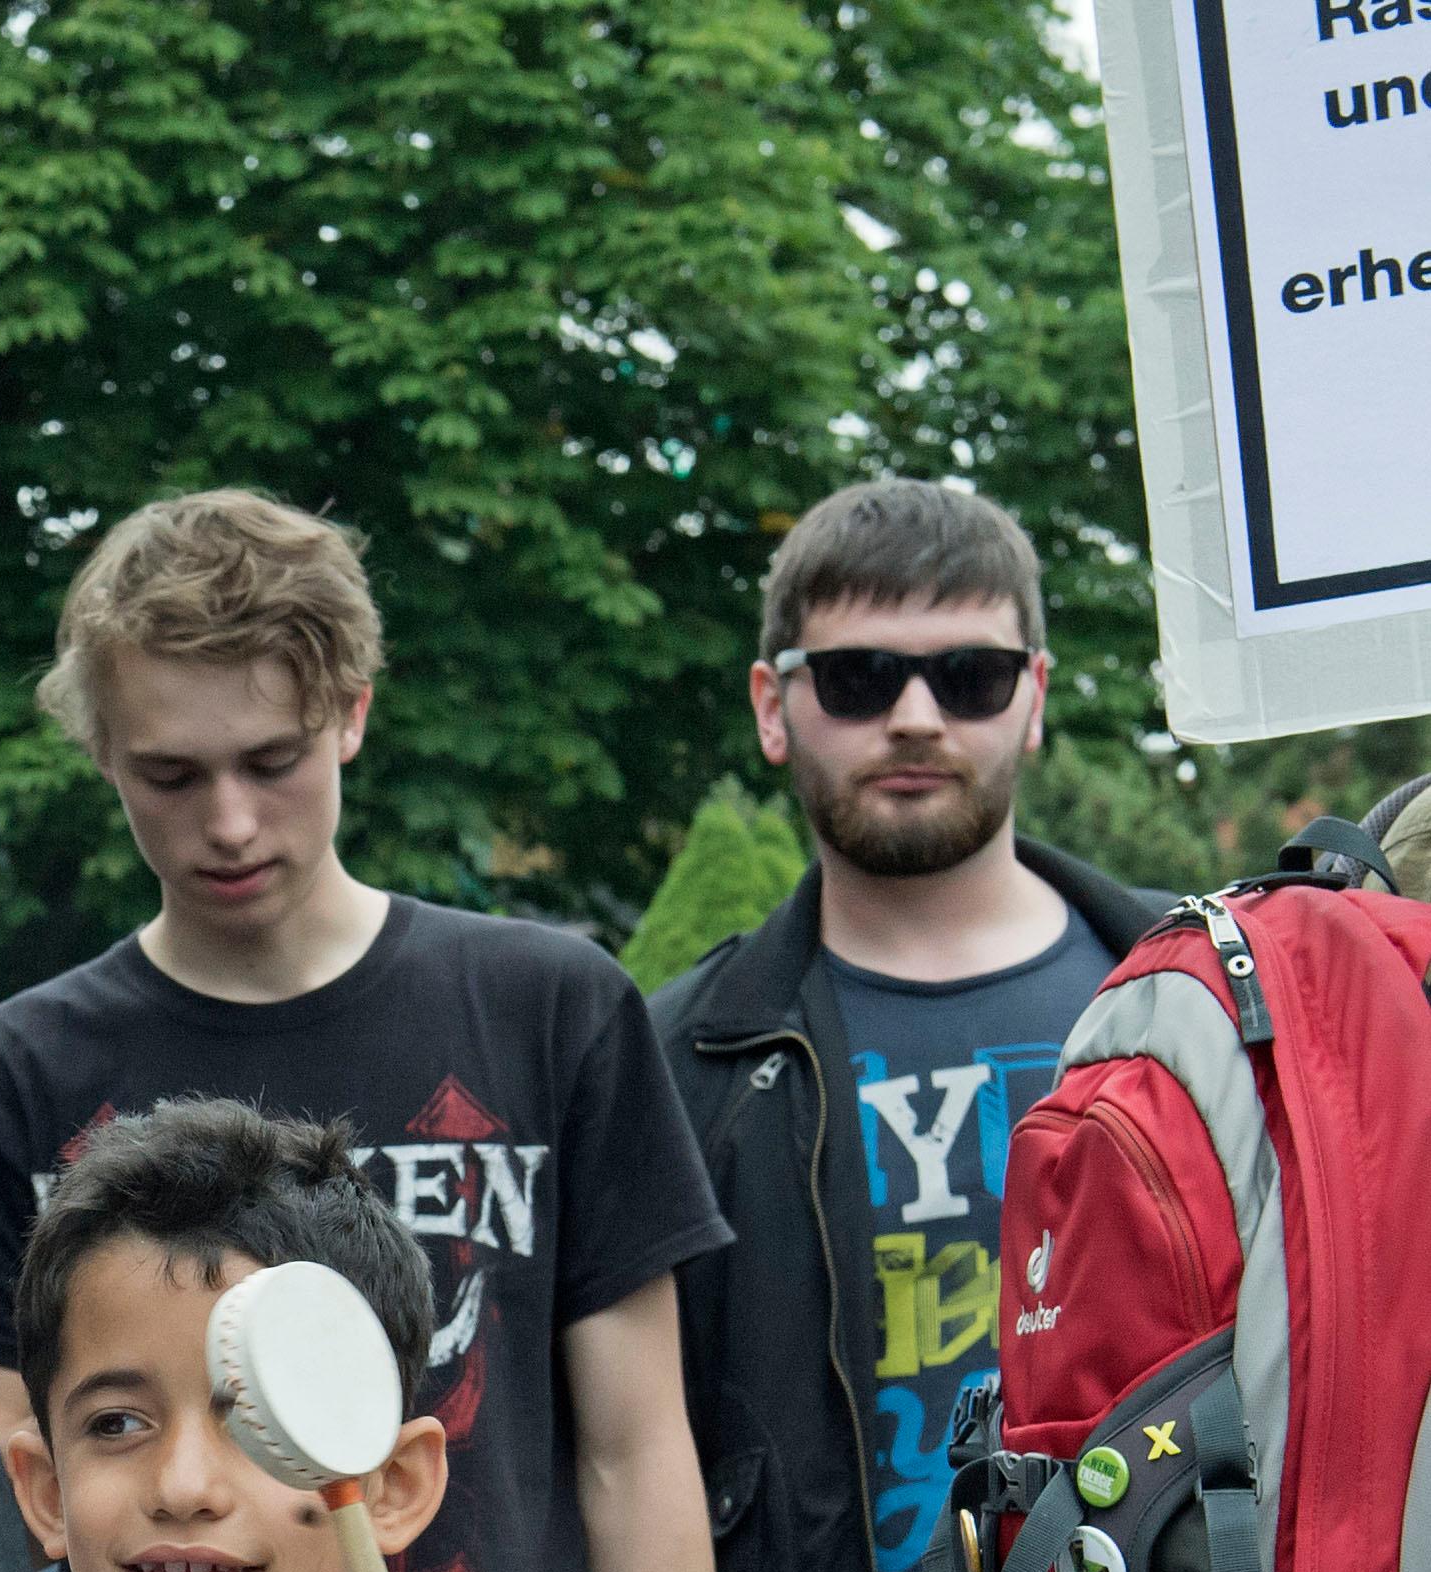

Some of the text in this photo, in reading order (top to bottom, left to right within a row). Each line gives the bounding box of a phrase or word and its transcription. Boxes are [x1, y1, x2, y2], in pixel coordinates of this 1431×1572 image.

[1315, 0, 1431, 41] Ra
[1324, 69, 1431, 128] un
[1016, 1301, 1061, 1336] deuter
